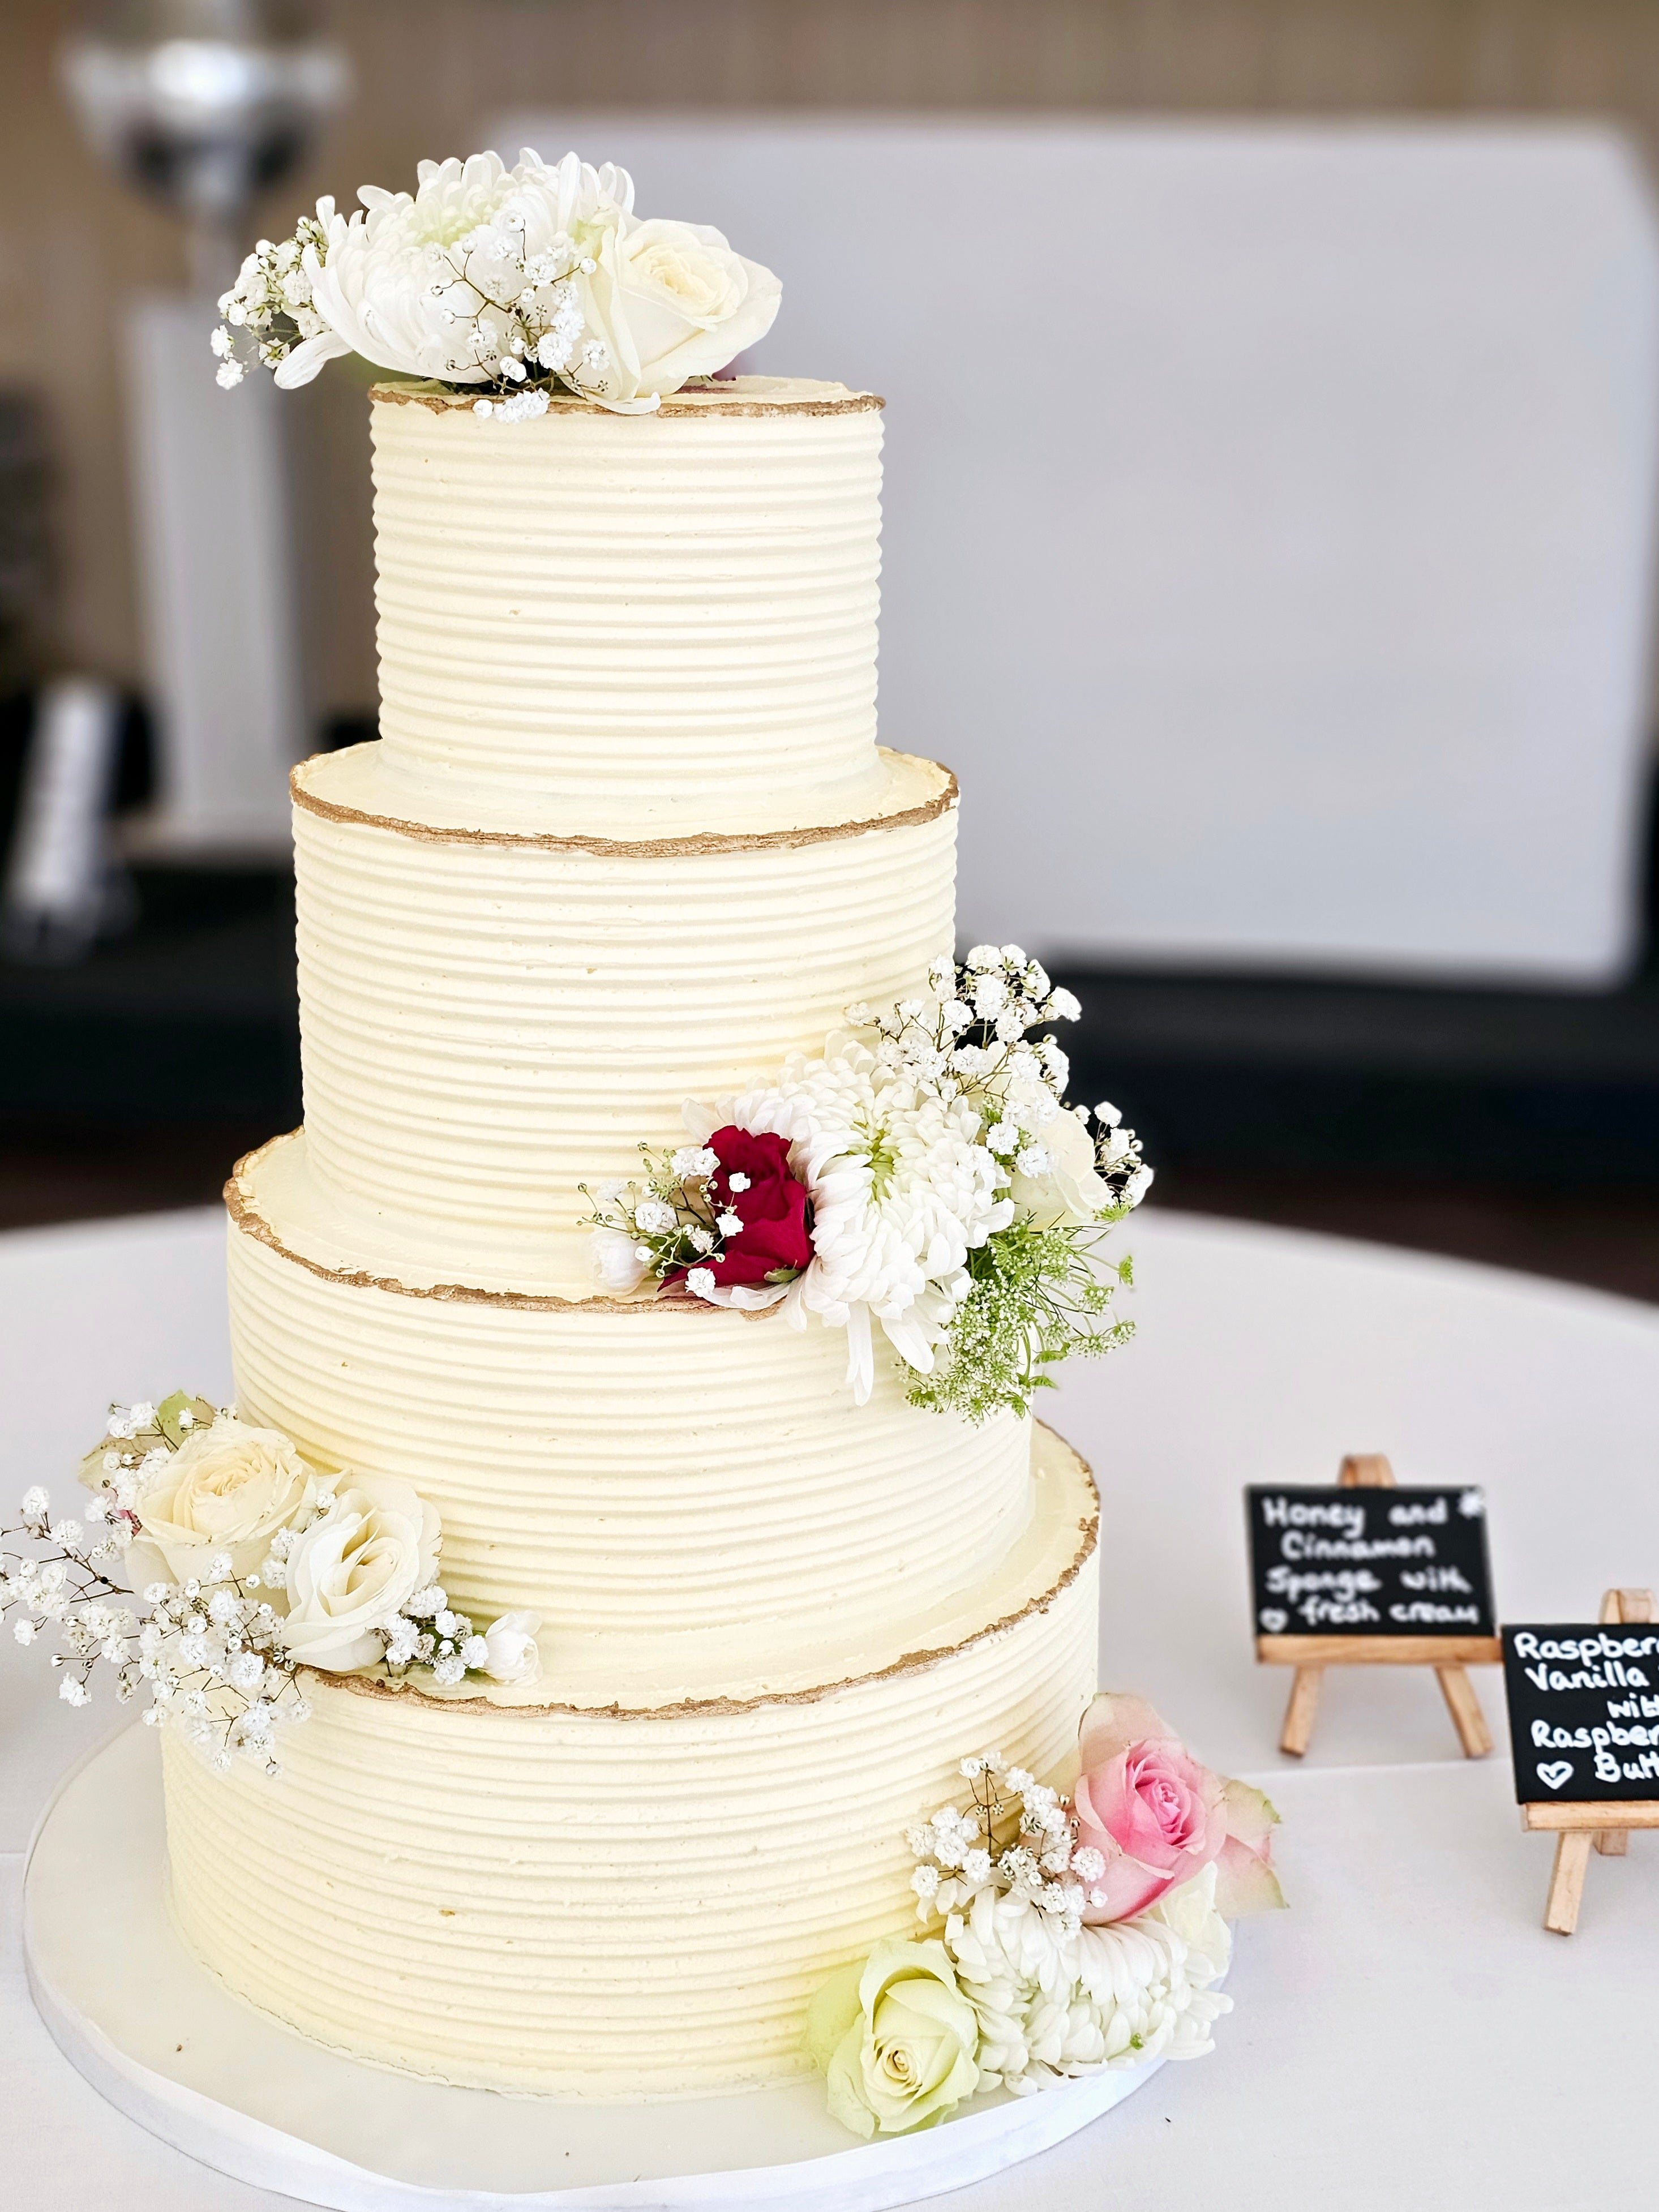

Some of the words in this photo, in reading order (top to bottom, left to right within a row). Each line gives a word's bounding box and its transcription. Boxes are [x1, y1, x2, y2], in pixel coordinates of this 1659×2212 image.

[1262, 1496, 1365, 1538] Honey
[1388, 1497, 1448, 1525] and
[1280, 1530, 1436, 1561] Cinnamon
[1265, 1564, 1382, 1603] Sponge
[1400, 1566, 1473, 1594] with
[1298, 1594, 1380, 1626] fresh
[1389, 1601, 1480, 1624] cream
[1514, 1632, 1659, 1667] Raspber
[1524, 1661, 1649, 1691] Vanilla
